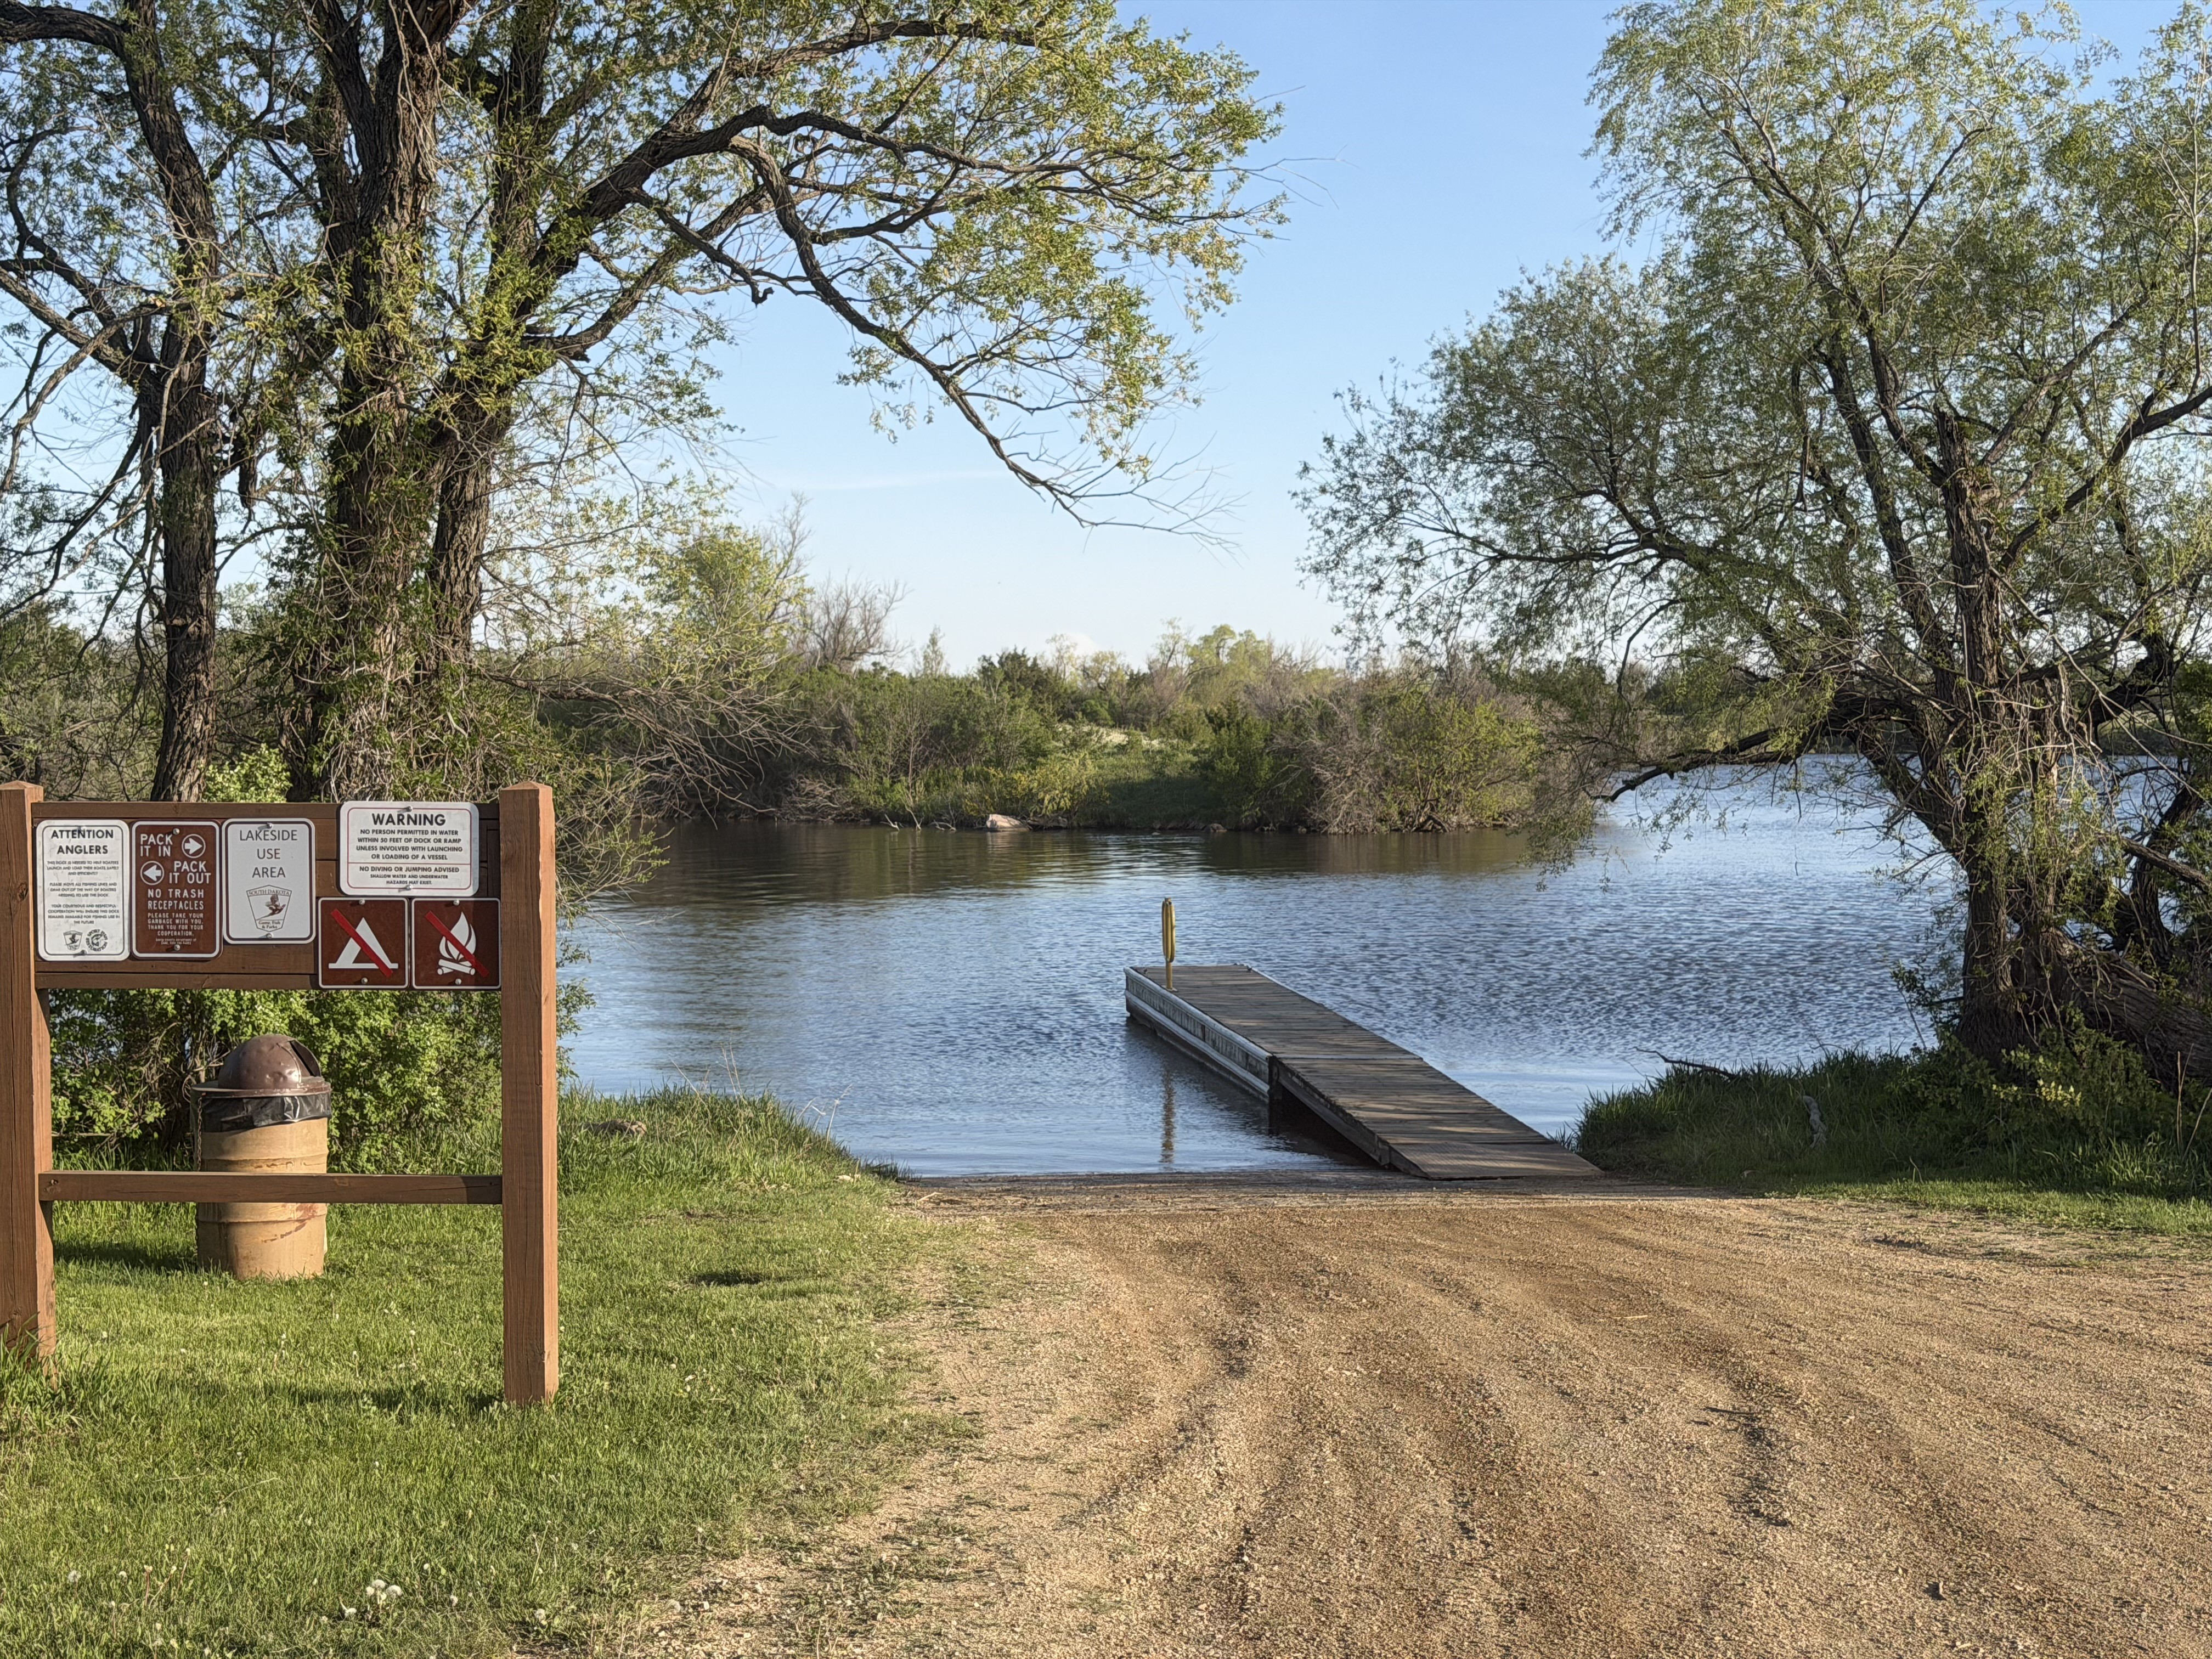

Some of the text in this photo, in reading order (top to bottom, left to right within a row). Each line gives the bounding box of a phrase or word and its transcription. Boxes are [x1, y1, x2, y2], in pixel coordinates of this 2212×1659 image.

[372, 813, 445, 826] WARNING
[51, 830, 114, 839] ATTENTION
[140, 834, 173, 845] PACK
[240, 830, 297, 840] LAKESIDE
[57, 845, 108, 854] ANGLERS
[140, 846, 171, 856] IT IN
[257, 849, 280, 859] USE
[174, 861, 206, 872] PACK
[252, 867, 286, 878] AREA
[170, 873, 211, 884] IT OUT
[148, 889, 204, 898] NO TRASH
[148, 901, 204, 910] RECEPTACLES
